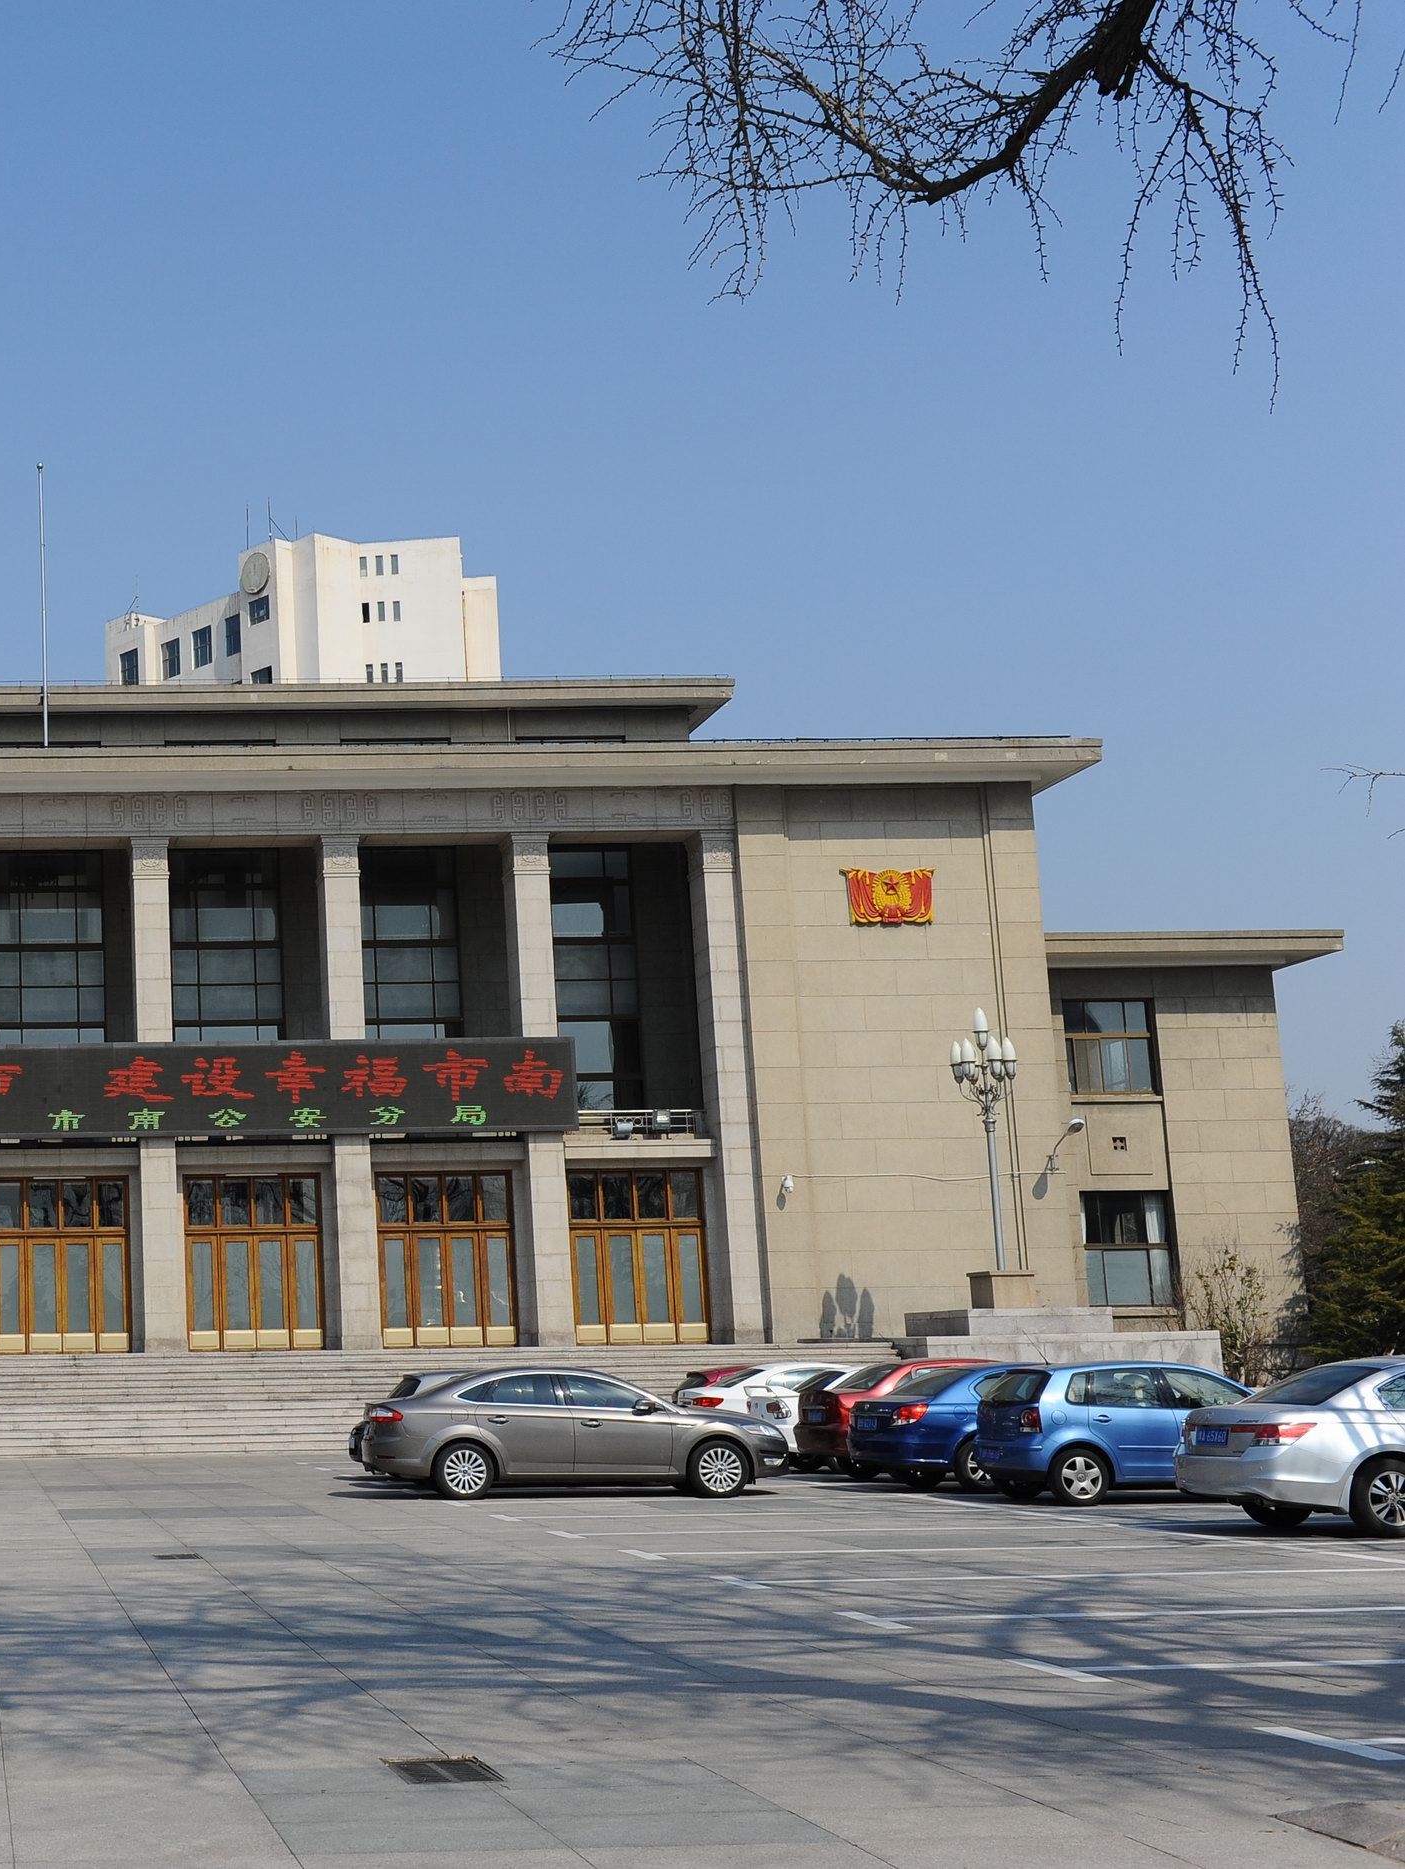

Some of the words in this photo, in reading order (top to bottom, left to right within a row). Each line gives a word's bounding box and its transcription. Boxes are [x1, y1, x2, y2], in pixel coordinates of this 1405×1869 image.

[102, 1049, 564, 1104] 建设幸福市南
[48, 1105, 489, 1131] 市南公安分局
